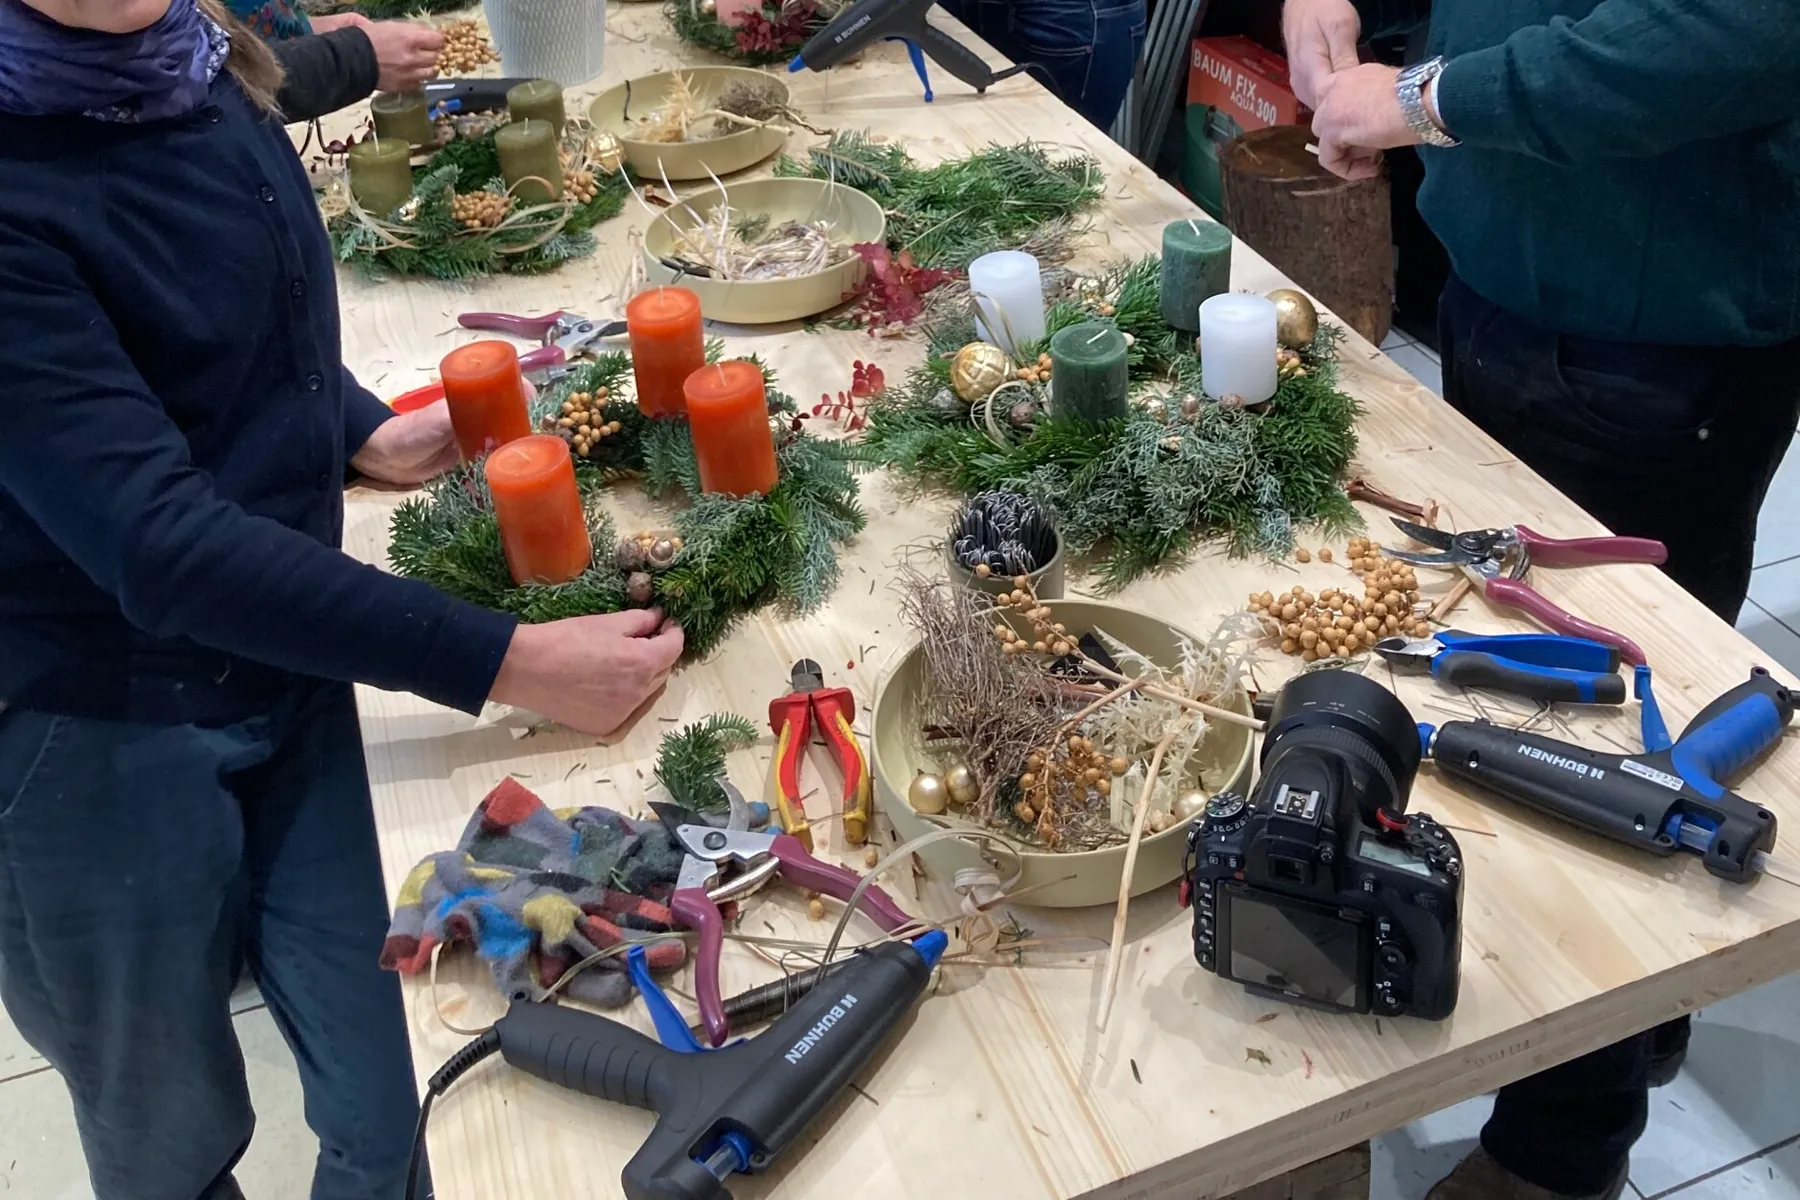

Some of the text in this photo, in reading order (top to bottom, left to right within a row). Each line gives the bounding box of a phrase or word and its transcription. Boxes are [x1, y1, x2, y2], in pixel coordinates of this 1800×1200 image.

[1193, 49, 1232, 88] BAUM
[1235, 73, 1257, 101] FIX
[1230, 90, 1277, 126] AQUA 300
[784, 1005, 846, 1065] BÜHNEN
